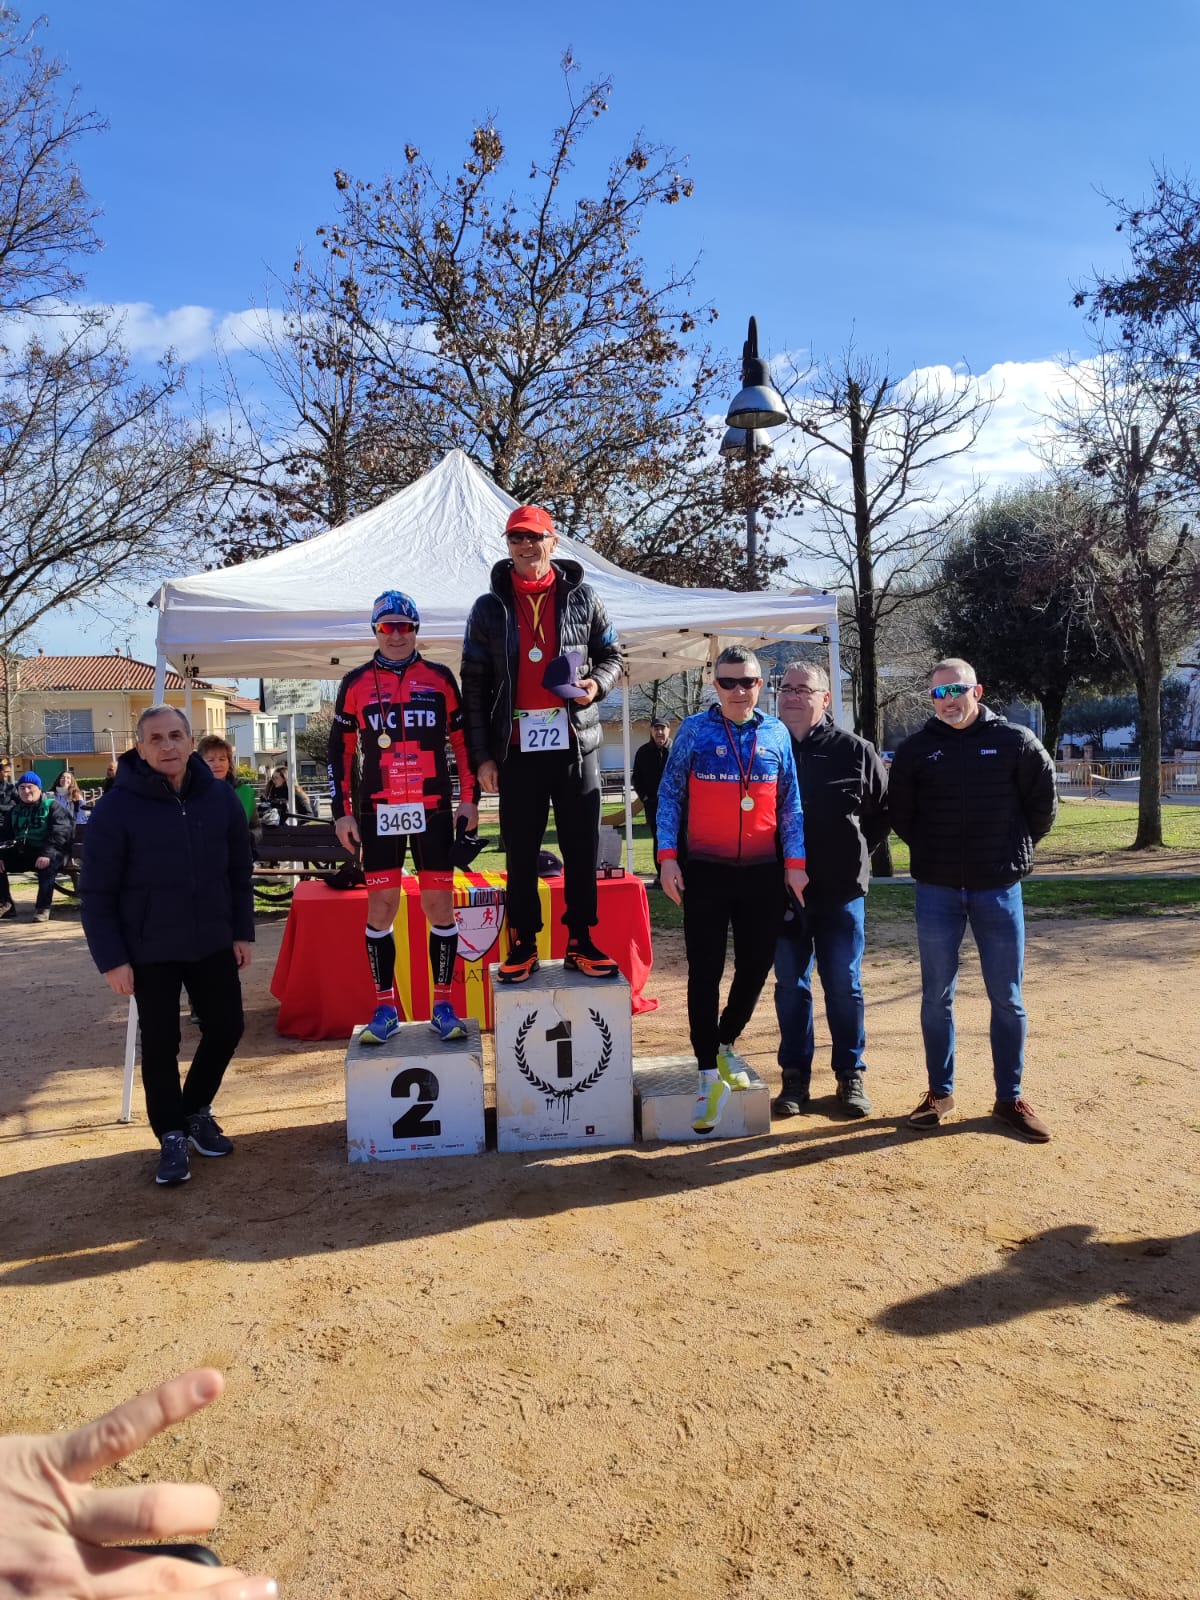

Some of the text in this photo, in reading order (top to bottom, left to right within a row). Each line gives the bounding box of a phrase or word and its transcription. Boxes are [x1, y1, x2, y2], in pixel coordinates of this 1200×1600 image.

[403, 709, 436, 728] ETB
[527, 726, 561, 748] 272
[696, 772, 716, 780] Club
[378, 810, 423, 832] 3463
[545, 1020, 573, 1079] 1
[390, 1067, 442, 1140] 2
